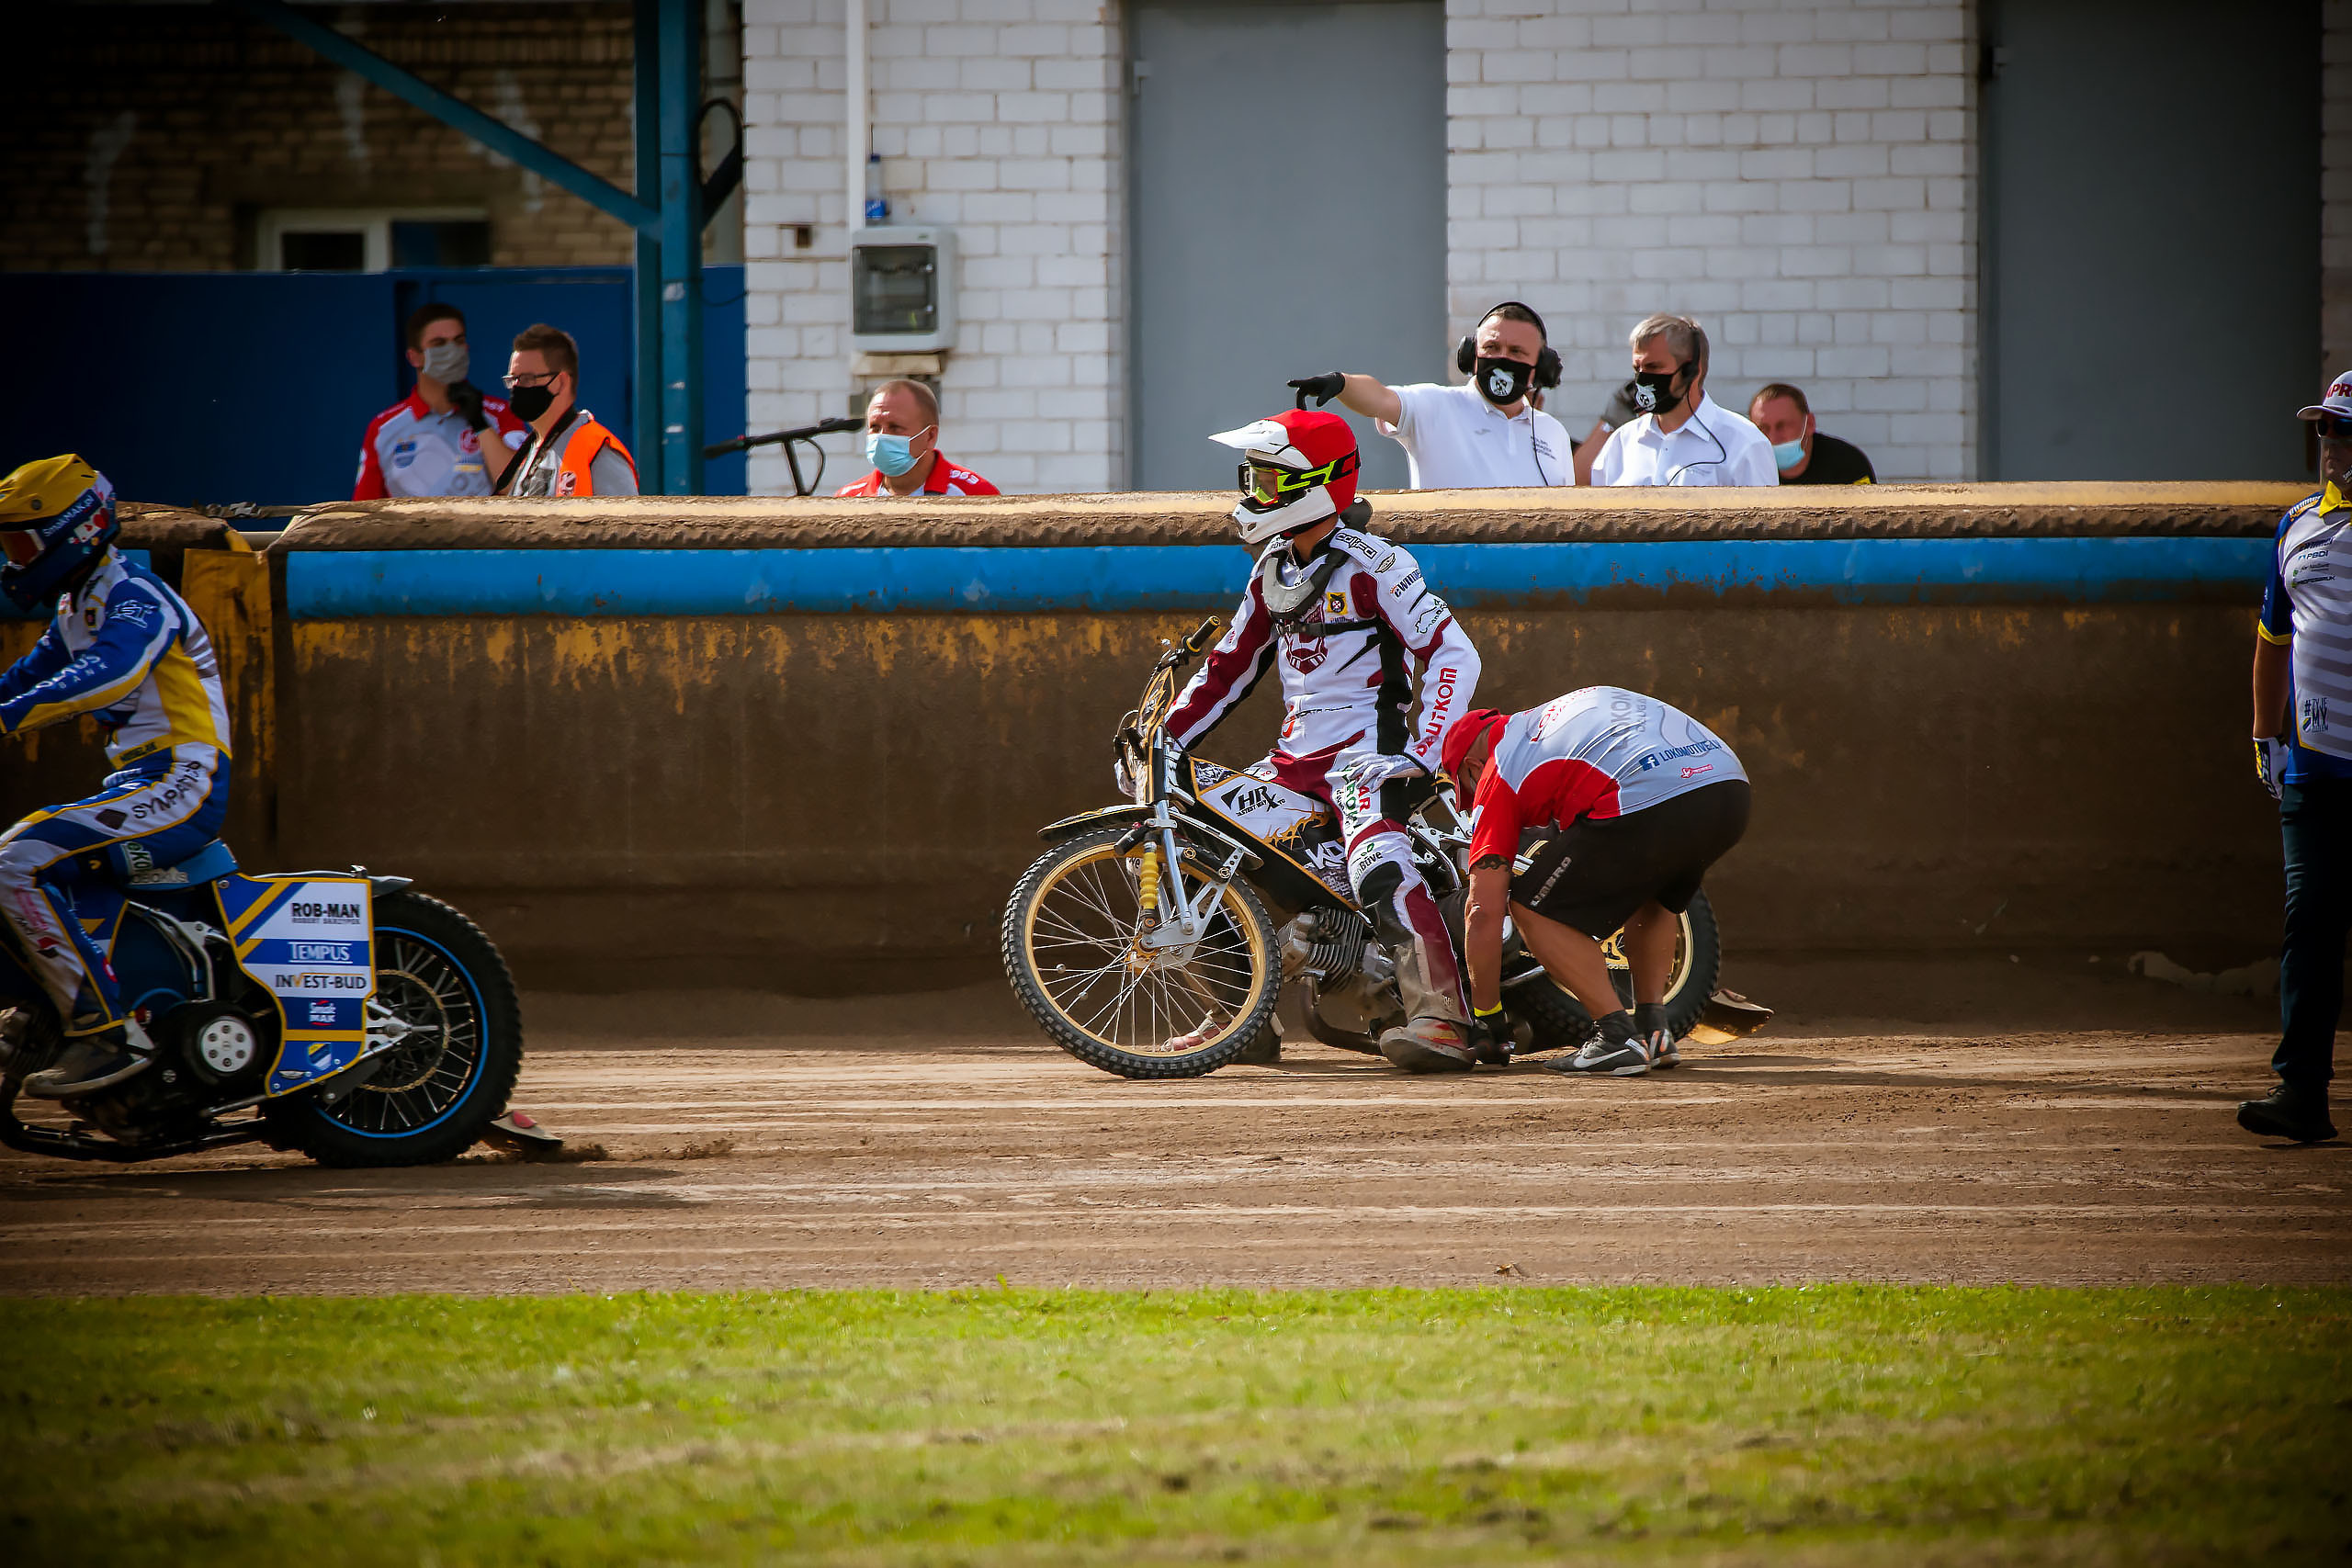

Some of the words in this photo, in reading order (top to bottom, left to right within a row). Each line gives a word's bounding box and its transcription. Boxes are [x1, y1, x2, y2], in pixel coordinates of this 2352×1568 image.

[291, 902, 361, 918] ROB-MAN
[291, 942, 351, 961] TEMPUS
[275, 973, 368, 989] INVEST-BUD
